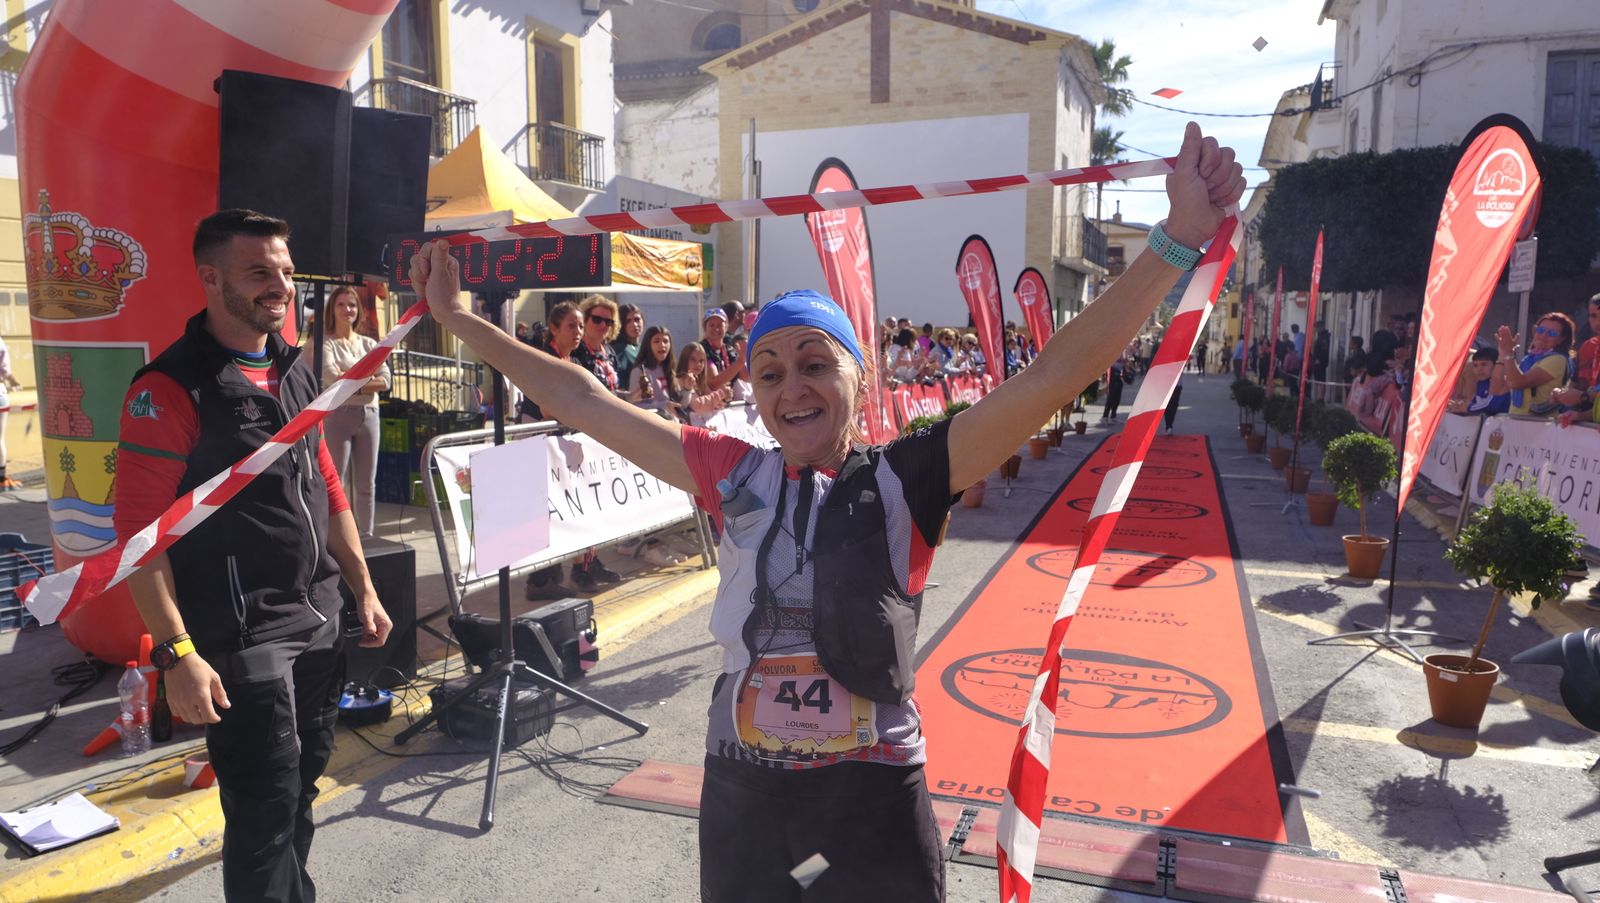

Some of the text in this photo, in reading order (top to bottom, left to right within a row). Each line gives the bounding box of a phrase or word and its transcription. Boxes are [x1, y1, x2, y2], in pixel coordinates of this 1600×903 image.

[1507, 445, 1600, 474] AYUNTAMIENT
[549, 472, 673, 521] ANTORI
[773, 678, 833, 714] 44
[1152, 674, 1191, 686] LA
[785, 720, 820, 730] LOURDES
[936, 780, 1165, 822] de Caoria
